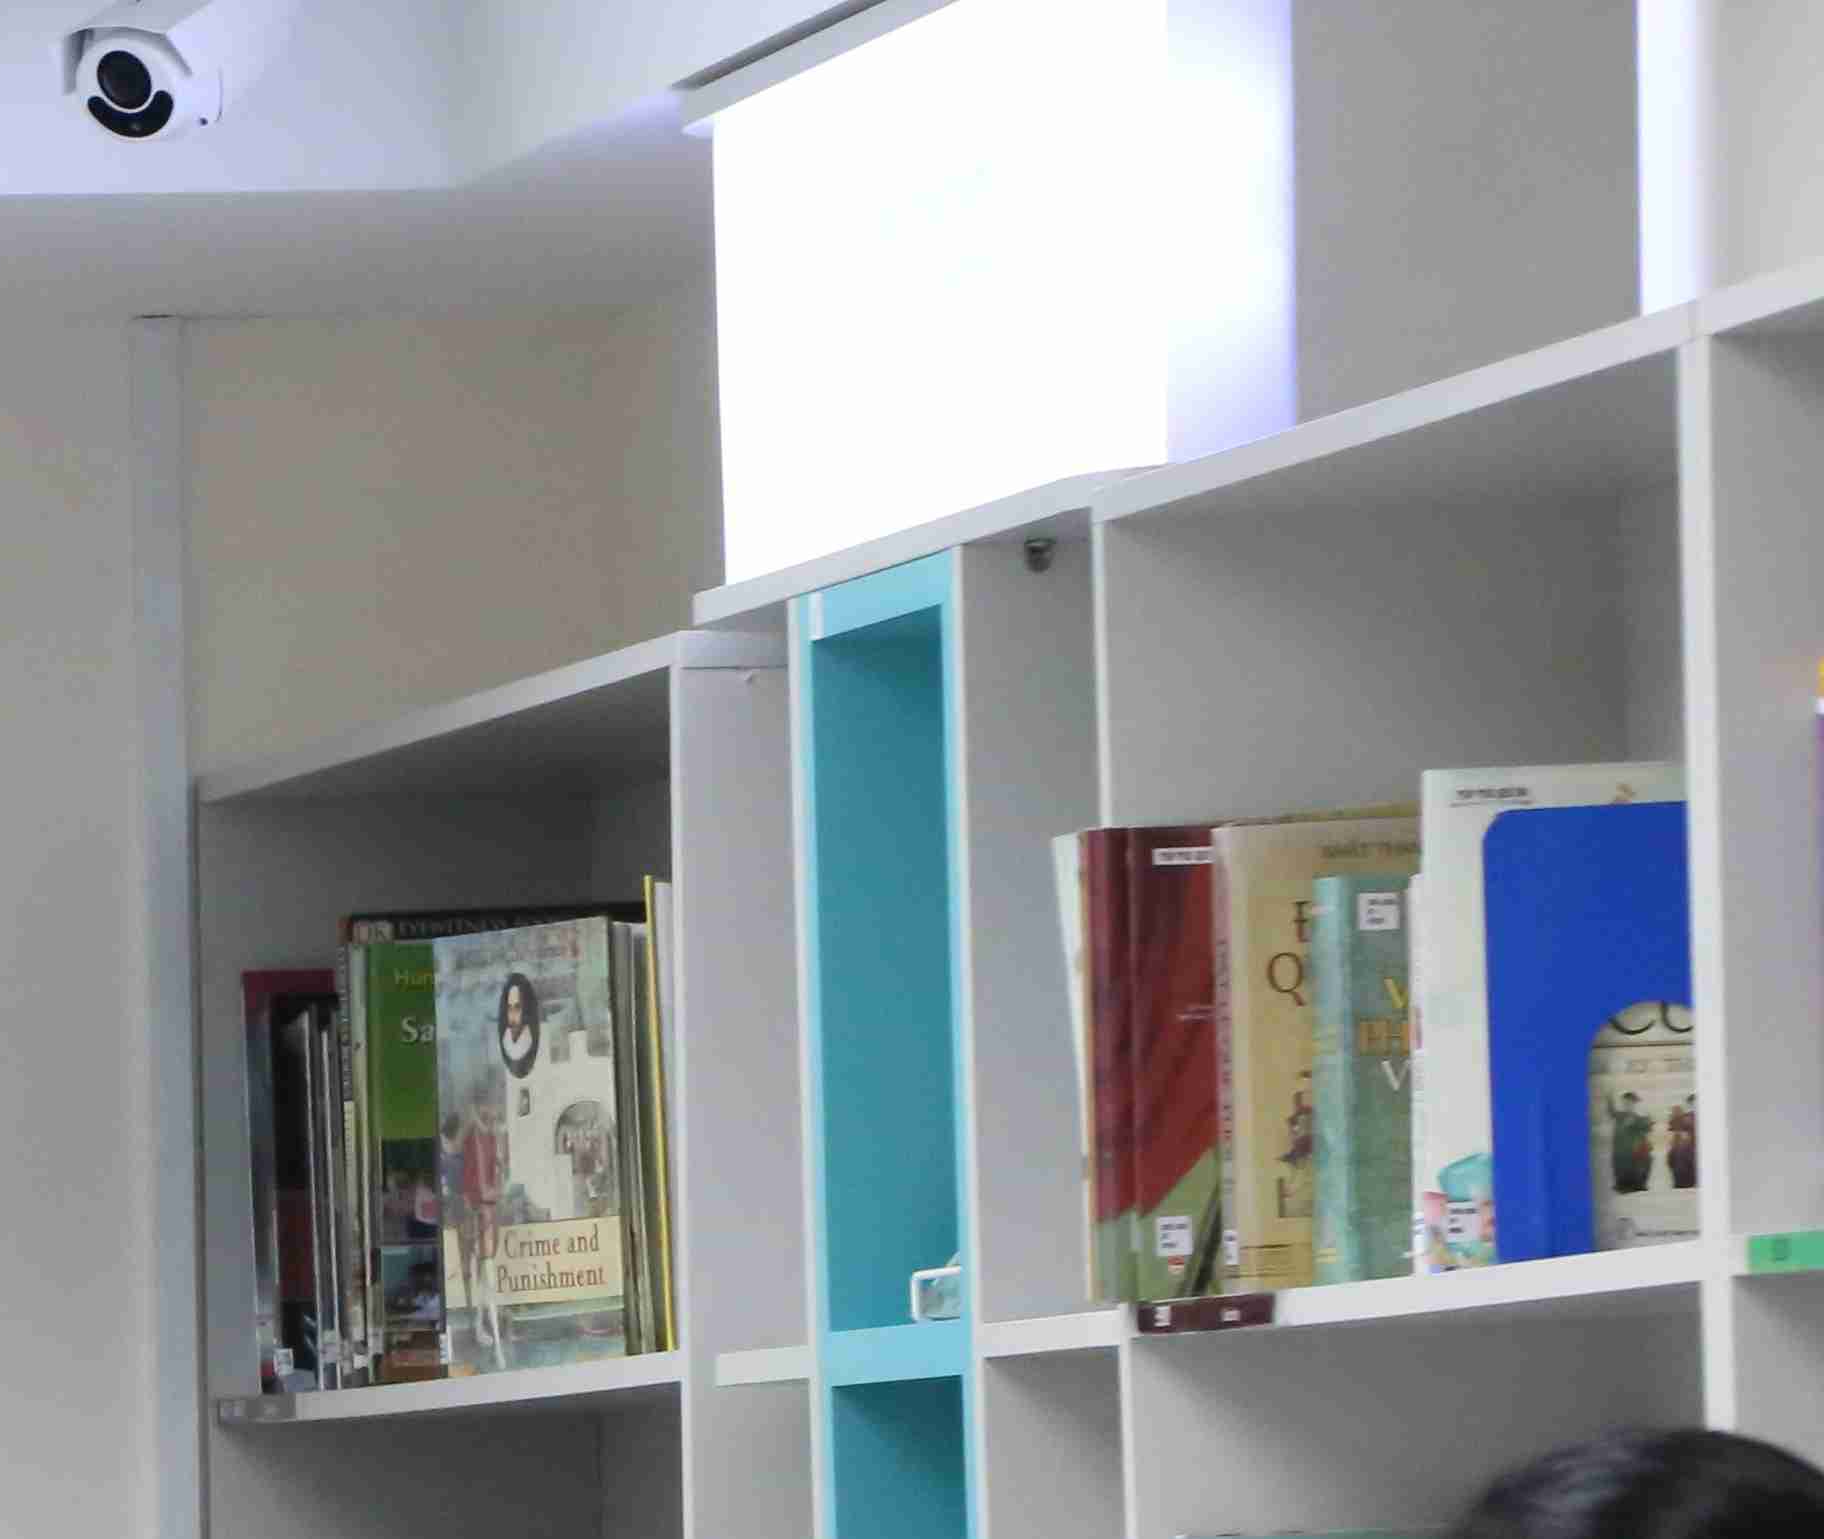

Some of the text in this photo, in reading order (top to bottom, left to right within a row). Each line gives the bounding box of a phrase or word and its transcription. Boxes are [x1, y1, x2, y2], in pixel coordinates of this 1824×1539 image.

[504, 1223, 599, 1258] Crime and
[496, 1261, 604, 1293] Punishment
